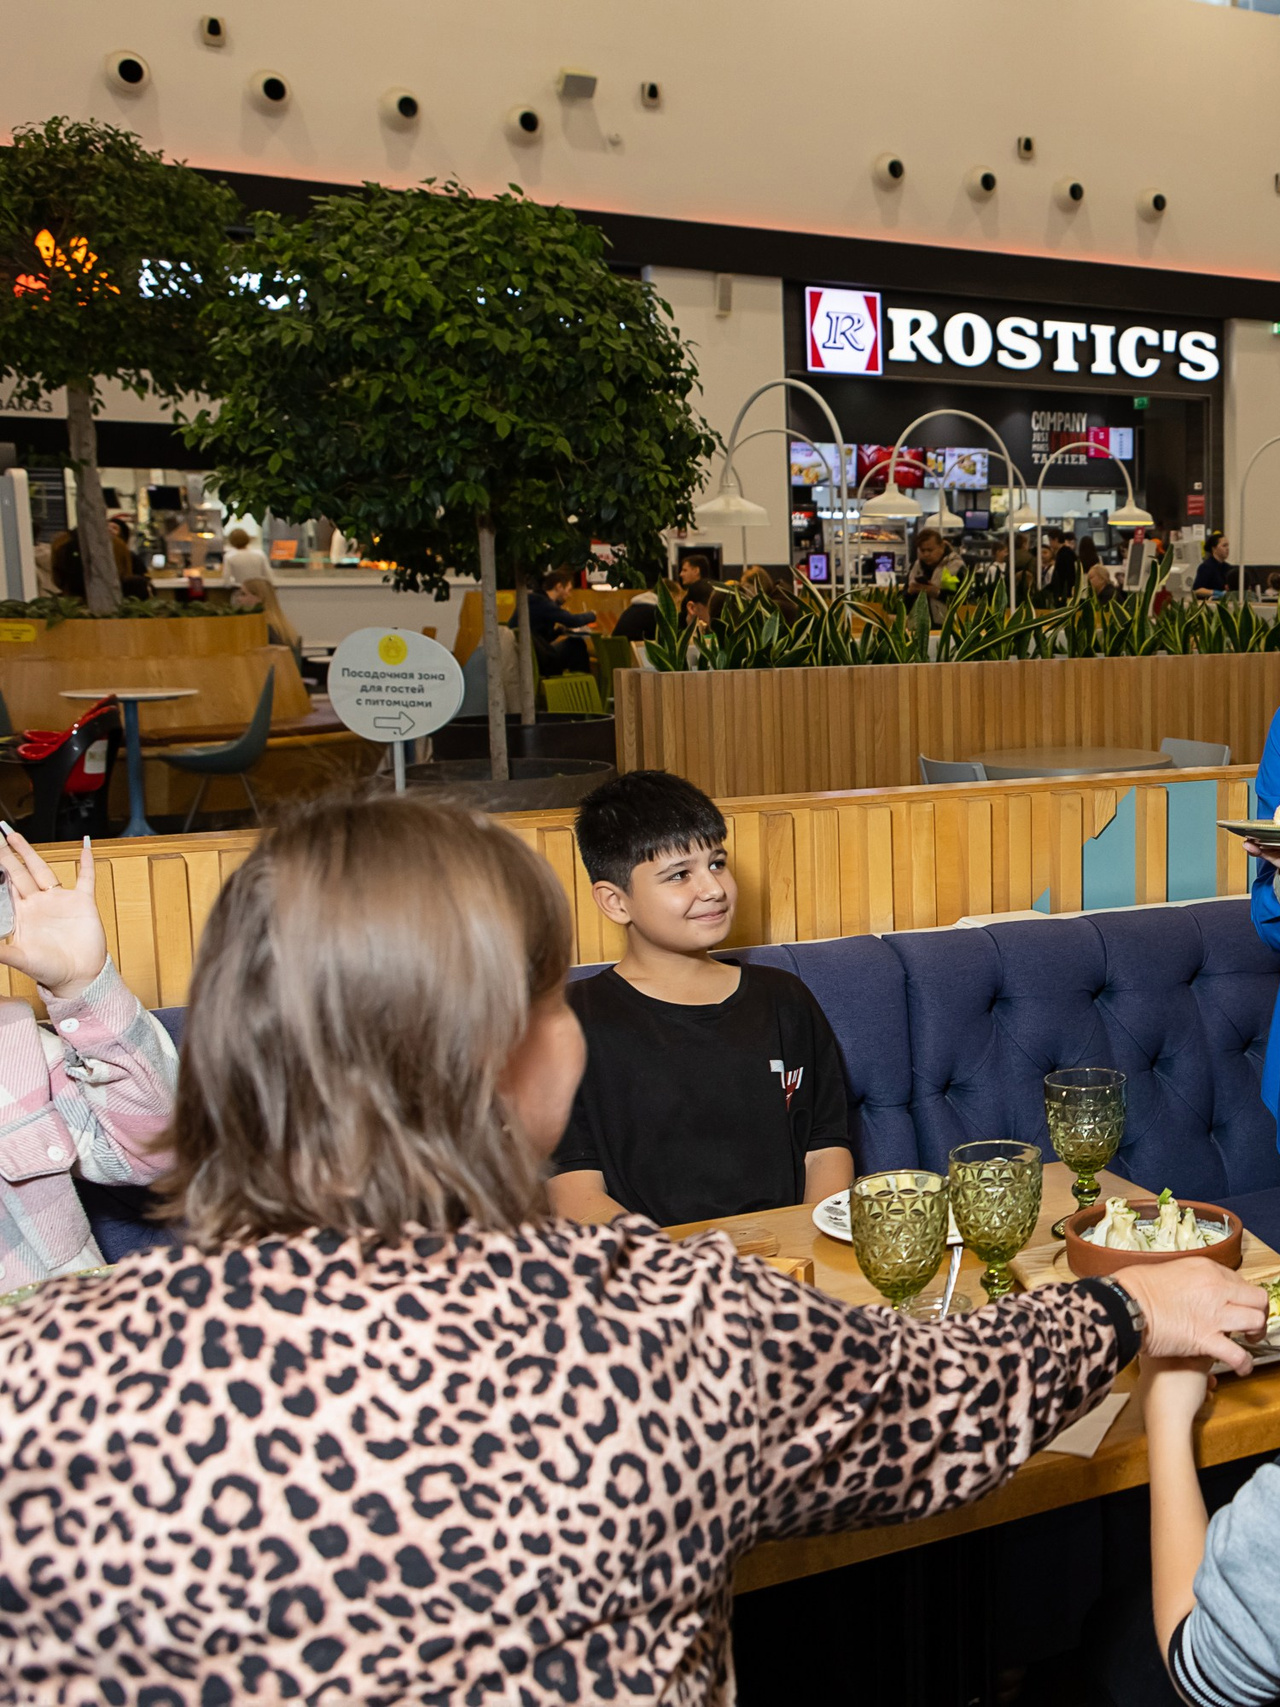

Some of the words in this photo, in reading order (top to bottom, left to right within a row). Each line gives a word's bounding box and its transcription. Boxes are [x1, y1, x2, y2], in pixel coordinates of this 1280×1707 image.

[887, 307, 1220, 382] ROSTIC'S
[0, 395, 53, 412] АКАЗ
[1031, 410, 1087, 432] COMPANY
[342, 667, 414, 680] Посадочная
[418, 672, 445, 681] зона
[360, 685, 382, 693] для
[385, 684, 424, 694] гостей
[356, 698, 362, 706] с
[365, 698, 432, 708] питомцами
